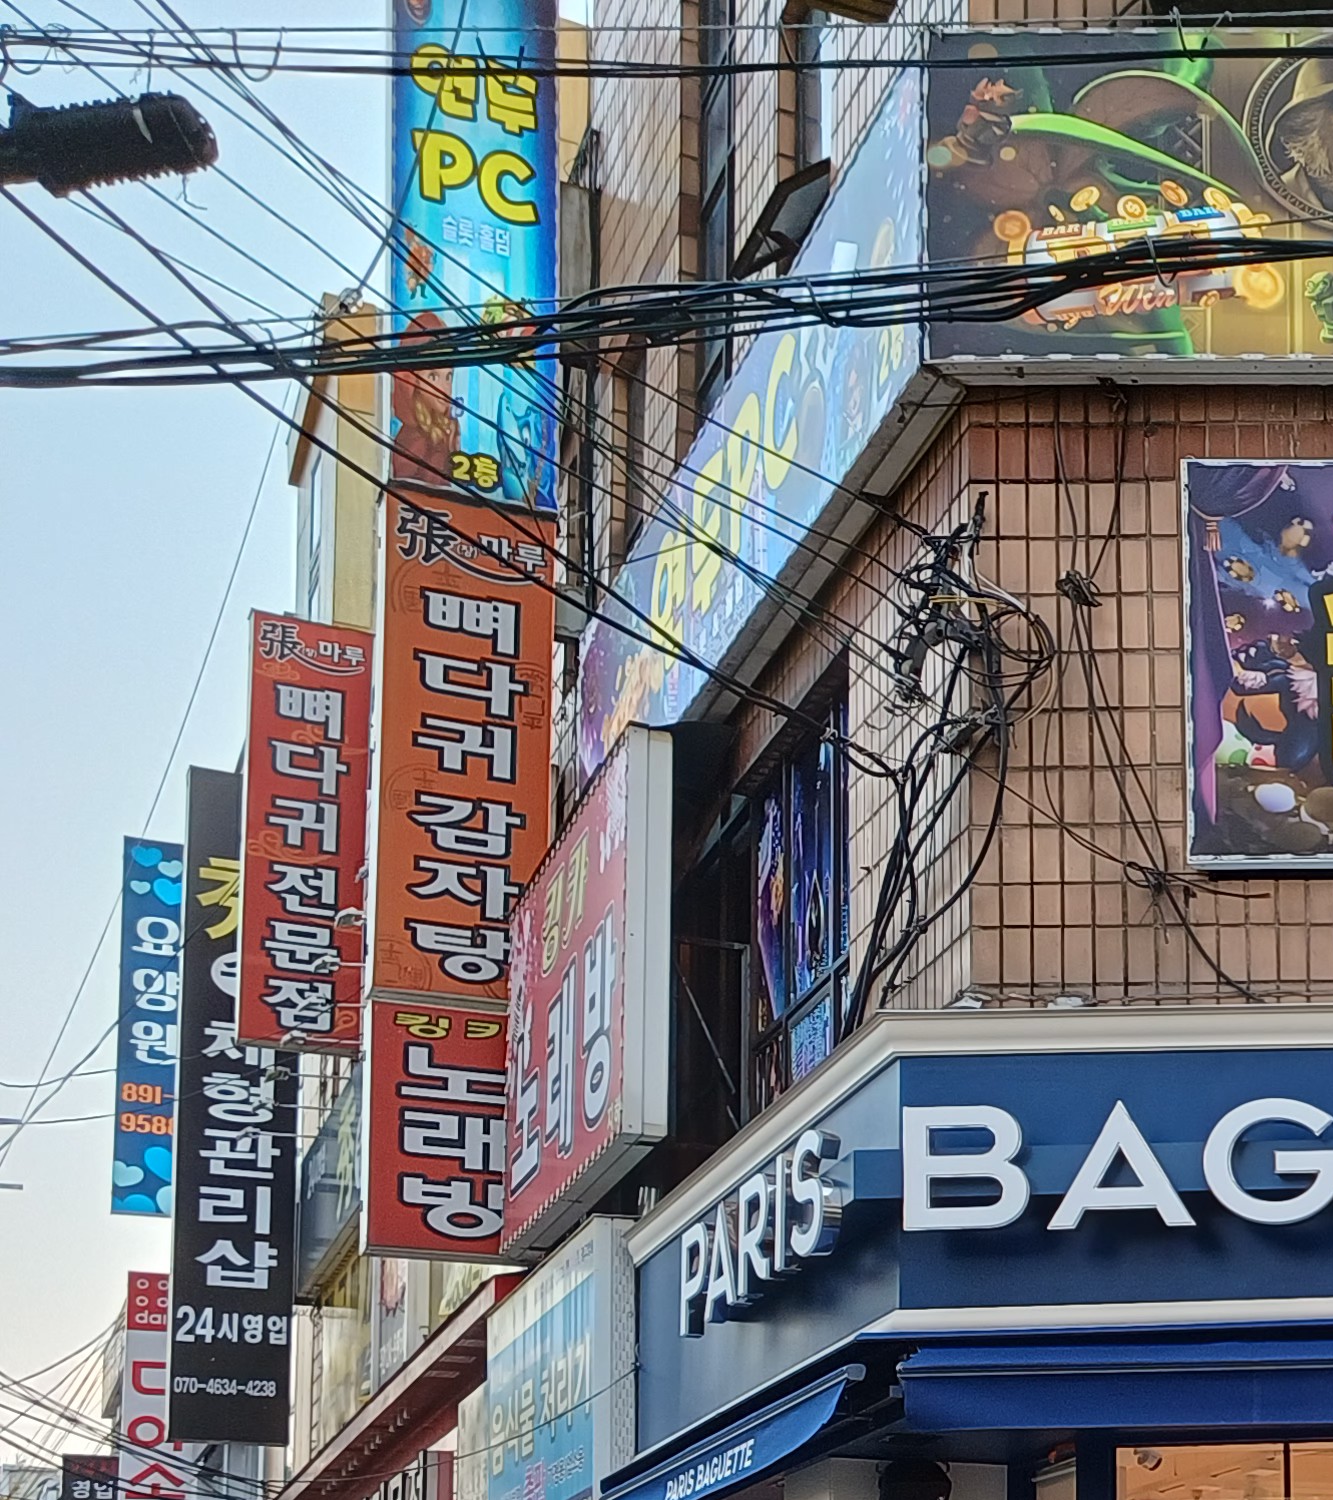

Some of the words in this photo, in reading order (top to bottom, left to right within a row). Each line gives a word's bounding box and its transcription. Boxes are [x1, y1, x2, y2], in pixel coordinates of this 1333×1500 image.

[410, 43, 539, 135] 연두
[411, 128, 540, 225] PC
[129, 915, 181, 1066] 요양원
[510, 900, 618, 1200] 노래방
[401, 1046, 506, 1239] 노래방
[680, 1128, 842, 1338] PARIS
[173, 1375, 277, 1398] 070-4634-4238
[174, 1305, 288, 1347] 24시영업
[490, 1377, 535, 1477] 음식물
[539, 1331, 591, 1442] 처리기
[695, 1438, 755, 1492] BAGUETTE
